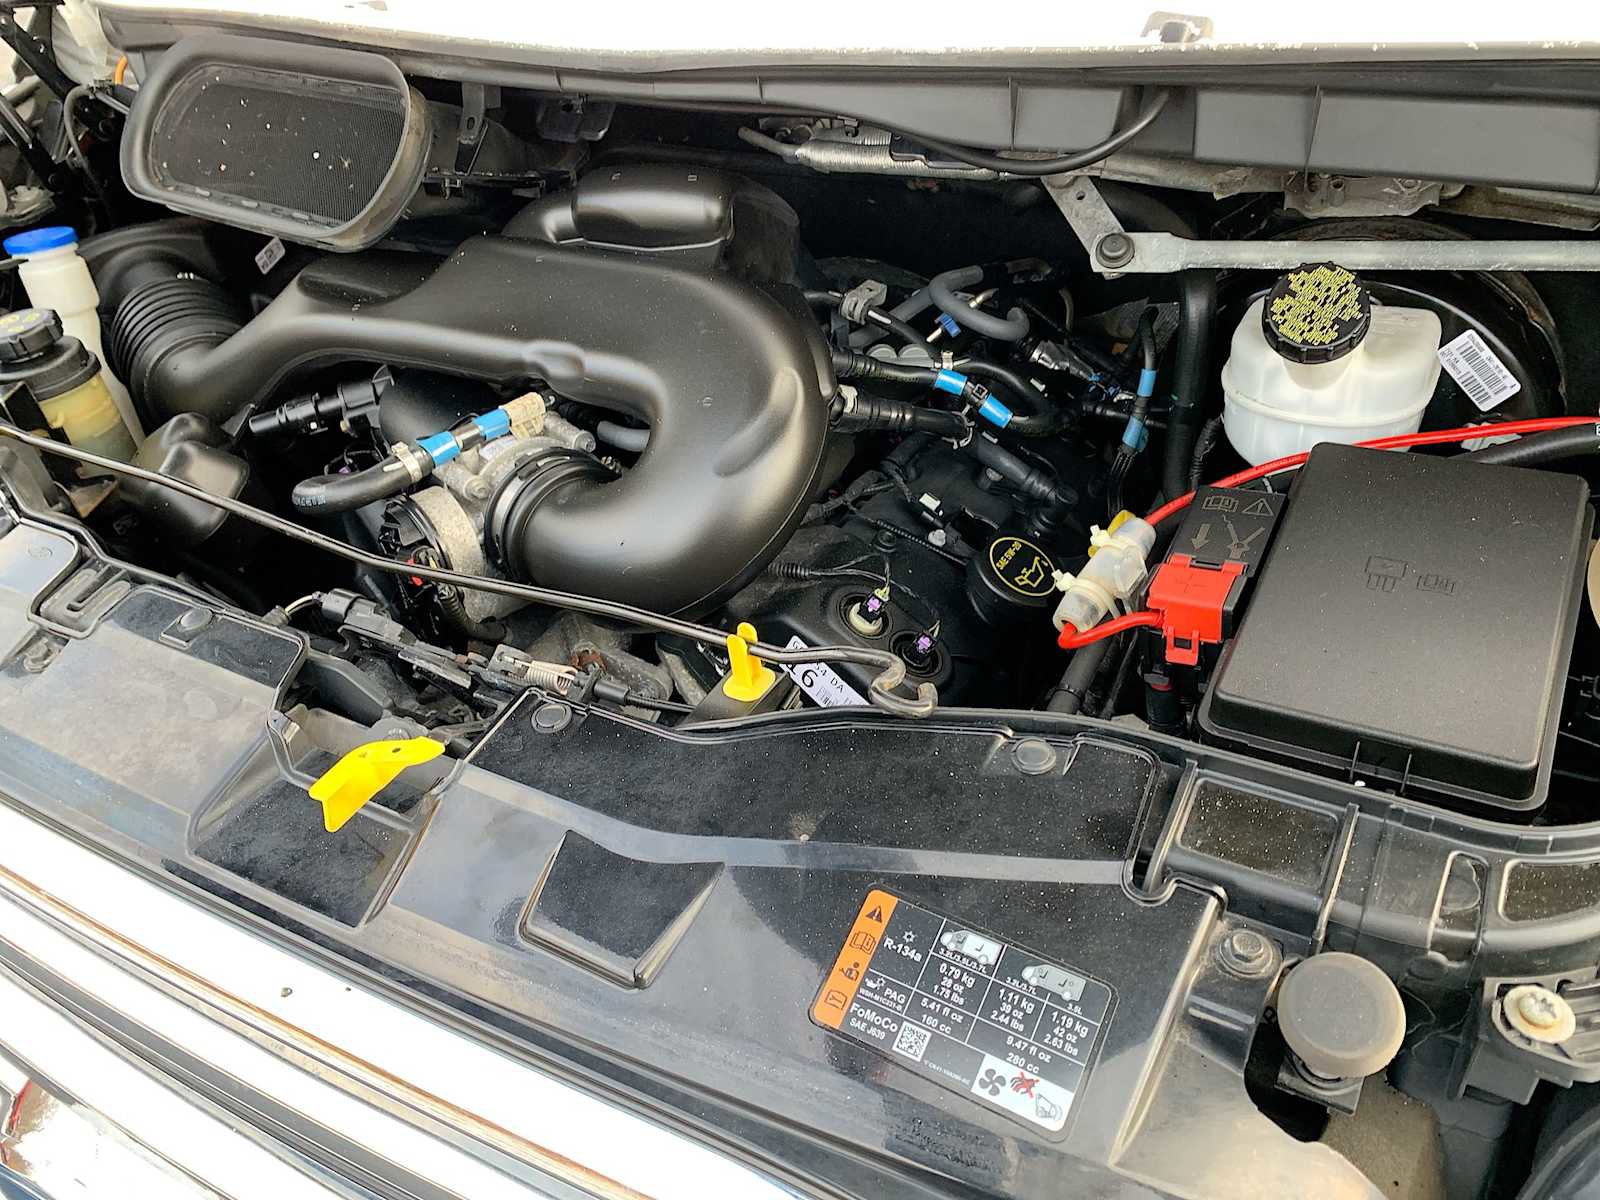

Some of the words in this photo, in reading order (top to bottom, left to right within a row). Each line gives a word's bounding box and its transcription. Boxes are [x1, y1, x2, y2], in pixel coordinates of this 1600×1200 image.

[830, 677, 844, 693] DA
[883, 936, 922, 962] R-134a
[940, 963, 961, 980] 0.79
[961, 971, 976, 988] kg
[940, 976, 953, 988] 28
[953, 982, 965, 994] oz
[884, 987, 906, 1004] PAG
[933, 985, 951, 998] 1.75
[950, 993, 964, 1005] lbs
[999, 988, 1020, 1005] 1.11
[1020, 997, 1035, 1014] kg
[849, 1002, 898, 1032] FoMoCo
[920, 997, 941, 1012] 5.41
[942, 1006, 950, 1016] fl
[951, 1012, 964, 1023] oz
[990, 1010, 1010, 1024] 2.44
[1010, 1018, 1024, 1032] lbs
[1000, 1002, 1012, 1014] 39
[1012, 1009, 1024, 1019] oz
[849, 1017, 867, 1032] SAE
[867, 1026, 886, 1040] J639
[922, 1014, 938, 1027] 160
[939, 1025, 952, 1034] cc
[1051, 1010, 1073, 1028] 1.19
[1074, 1020, 1089, 1038] kg
[1053, 1026, 1065, 1037] 42
[1065, 1033, 1077, 1043] oz
[1006, 1035, 1028, 1052] 9.47
[1028, 1045, 1038, 1056] fl
[1038, 1052, 1052, 1063] oz
[1043, 1033, 1063, 1049] 2.63
[1063, 1042, 1079, 1056] lbs
[1006, 1052, 1026, 1067] 280
[1026, 1063, 1040, 1074] cc
